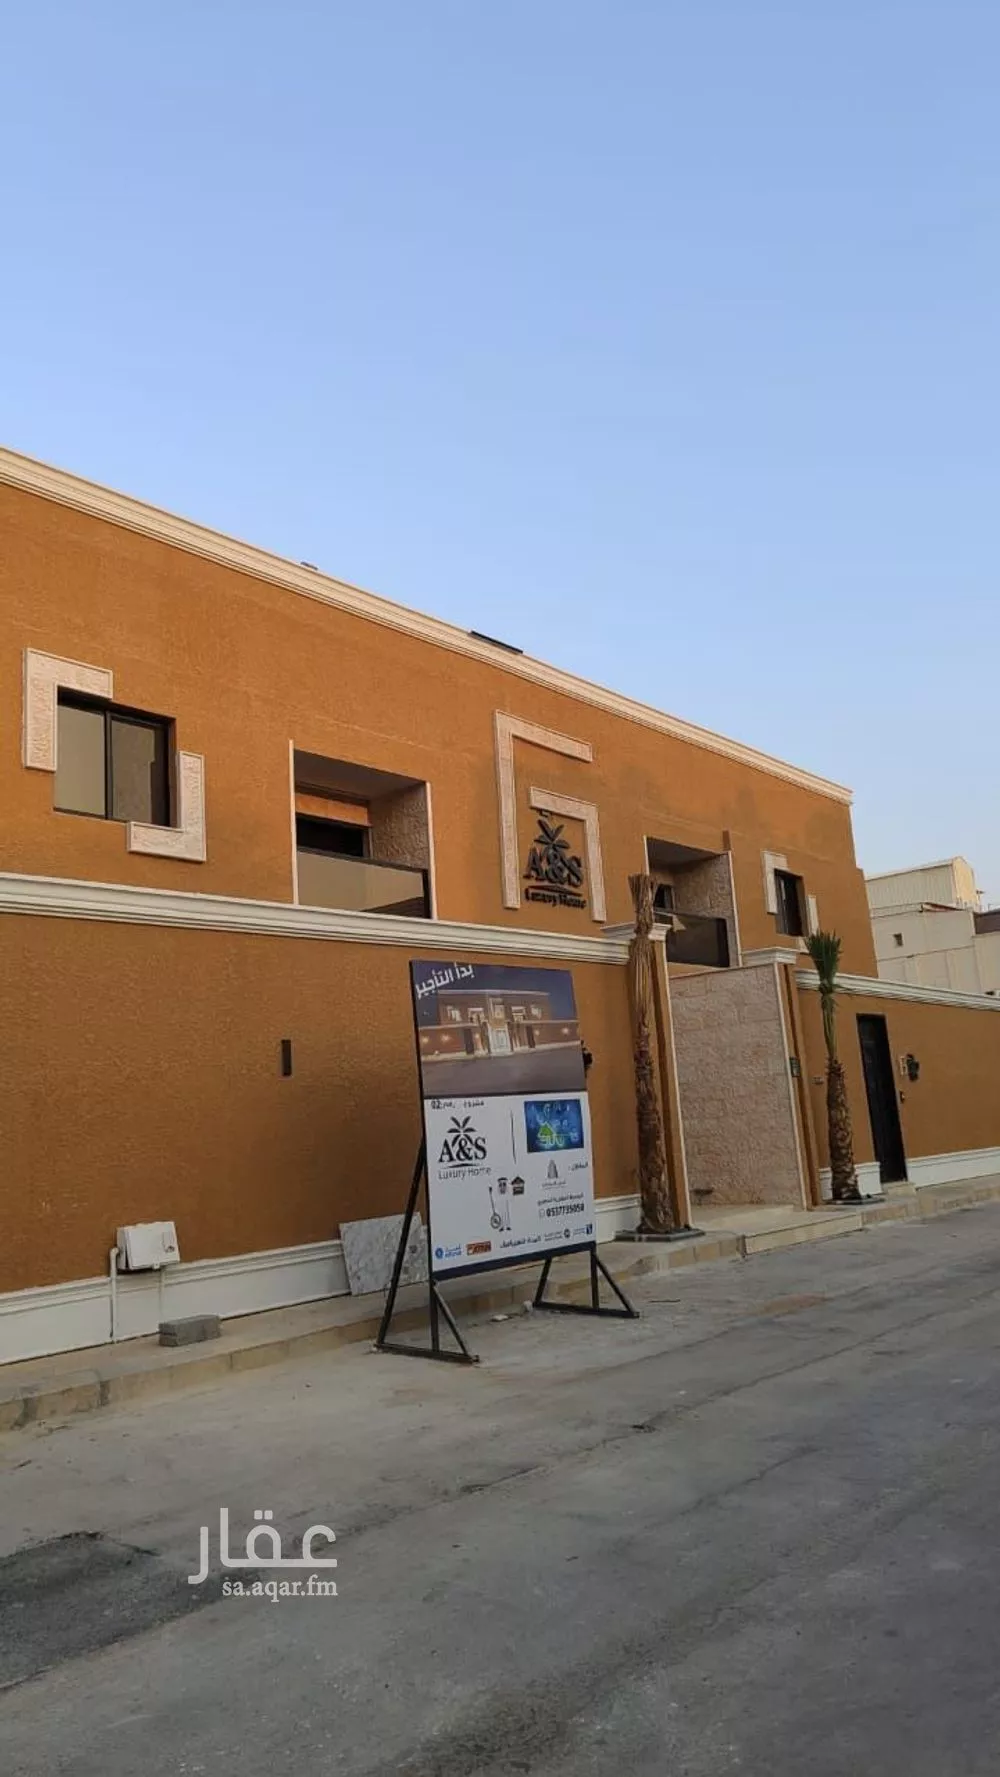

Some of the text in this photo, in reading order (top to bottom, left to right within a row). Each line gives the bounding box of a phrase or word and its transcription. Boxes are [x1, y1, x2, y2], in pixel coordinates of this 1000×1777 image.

[523, 846, 584, 888] A&S
[415, 961, 476, 1000] بدأ التأجير
[438, 1136, 487, 1163] A&S
[438, 1167, 492, 1180] Luxury Home
